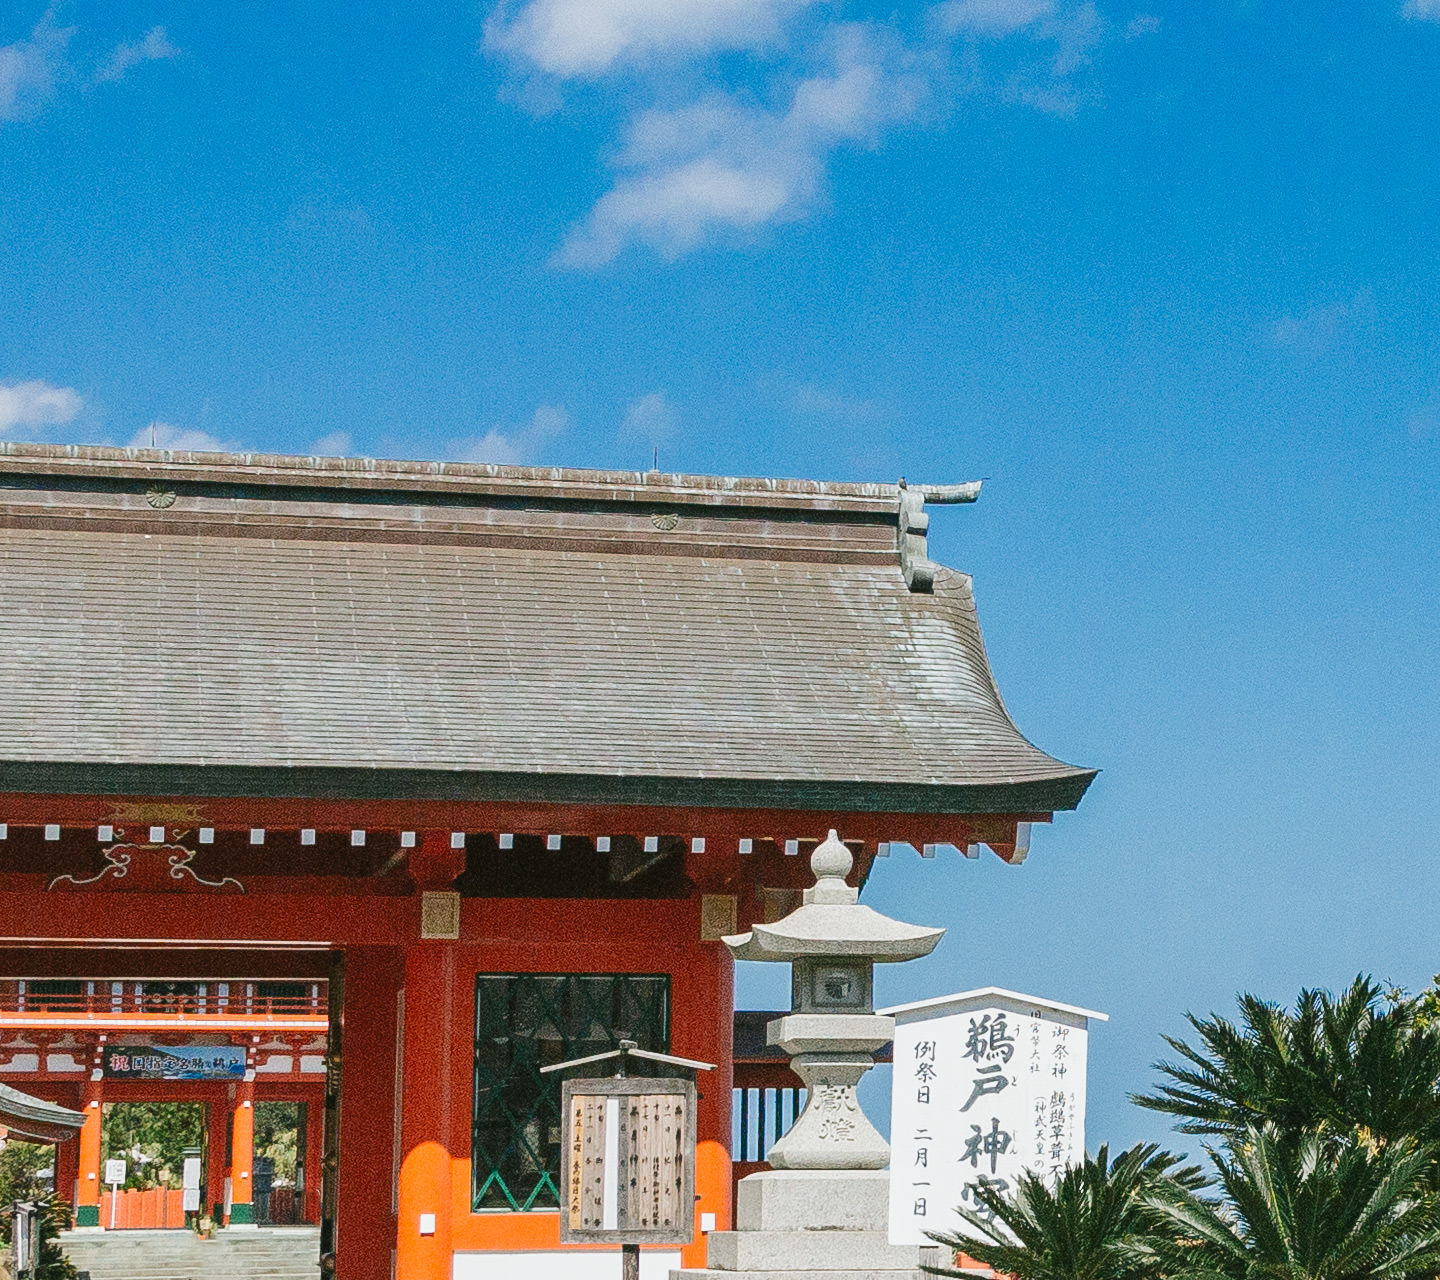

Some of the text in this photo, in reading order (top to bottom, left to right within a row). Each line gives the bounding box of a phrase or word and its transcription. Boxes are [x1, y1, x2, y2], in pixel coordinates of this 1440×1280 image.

[912, 1040, 938, 1217] 例祭日 二月一日
